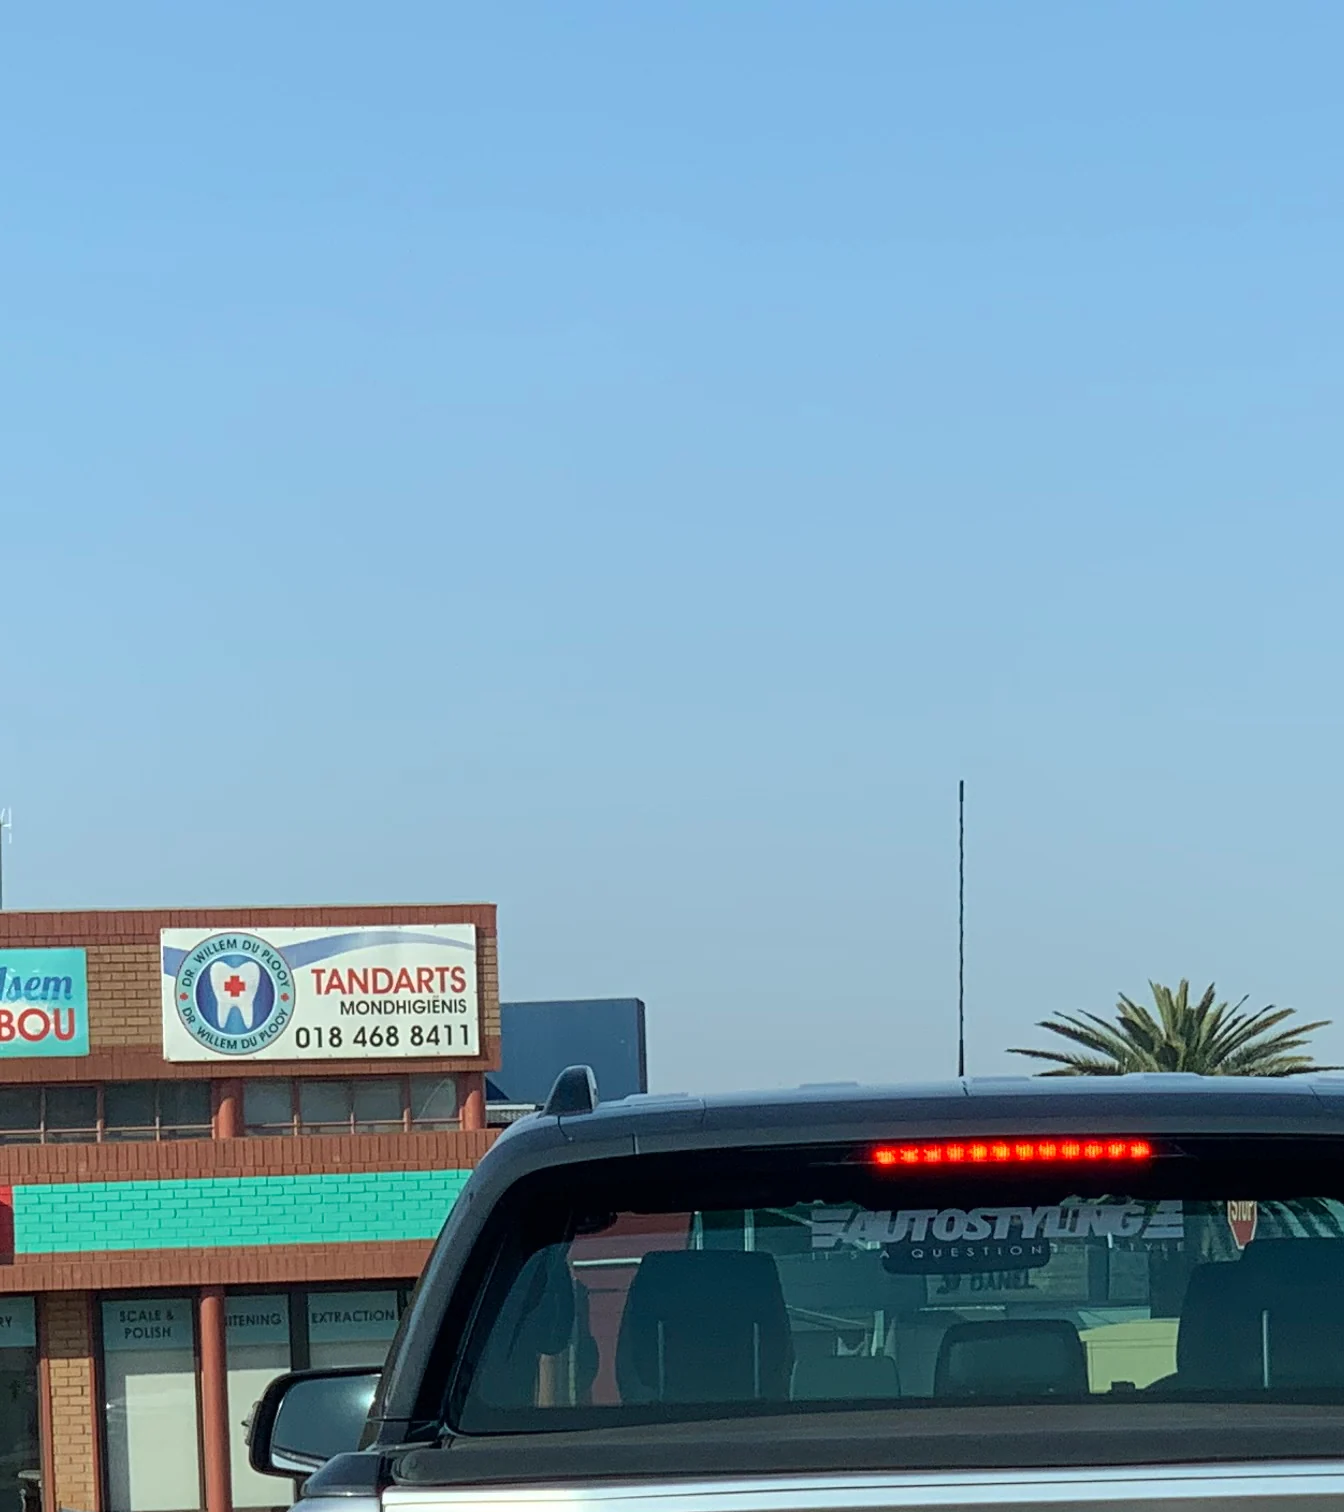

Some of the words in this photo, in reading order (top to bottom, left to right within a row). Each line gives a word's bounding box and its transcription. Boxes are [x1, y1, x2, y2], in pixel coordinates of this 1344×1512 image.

[194, 939, 237, 964] WILLEM
[242, 940, 260, 953] DU
[261, 950, 290, 987] PLOOY
[311, 966, 467, 995] TANDARTS
[340, 995, 467, 1015] MONDHIGIËNIS
[197, 1026, 237, 1049] WILLEM
[241, 1037, 257, 1050] DU
[260, 1008, 288, 1041] PLOOY
[295, 1026, 342, 1048] 018
[353, 1025, 399, 1047] 468
[410, 1024, 469, 1046] 8411
[843, 1204, 1146, 1243] AUTOSTYLING
[911, 1246, 1042, 1258] QUESTION
[120, 1310, 161, 1323] SCALE
[226, 1313, 282, 1327] ITENING
[311, 1309, 396, 1324] EXTRACTION
[124, 1327, 171, 1339] POLISH
